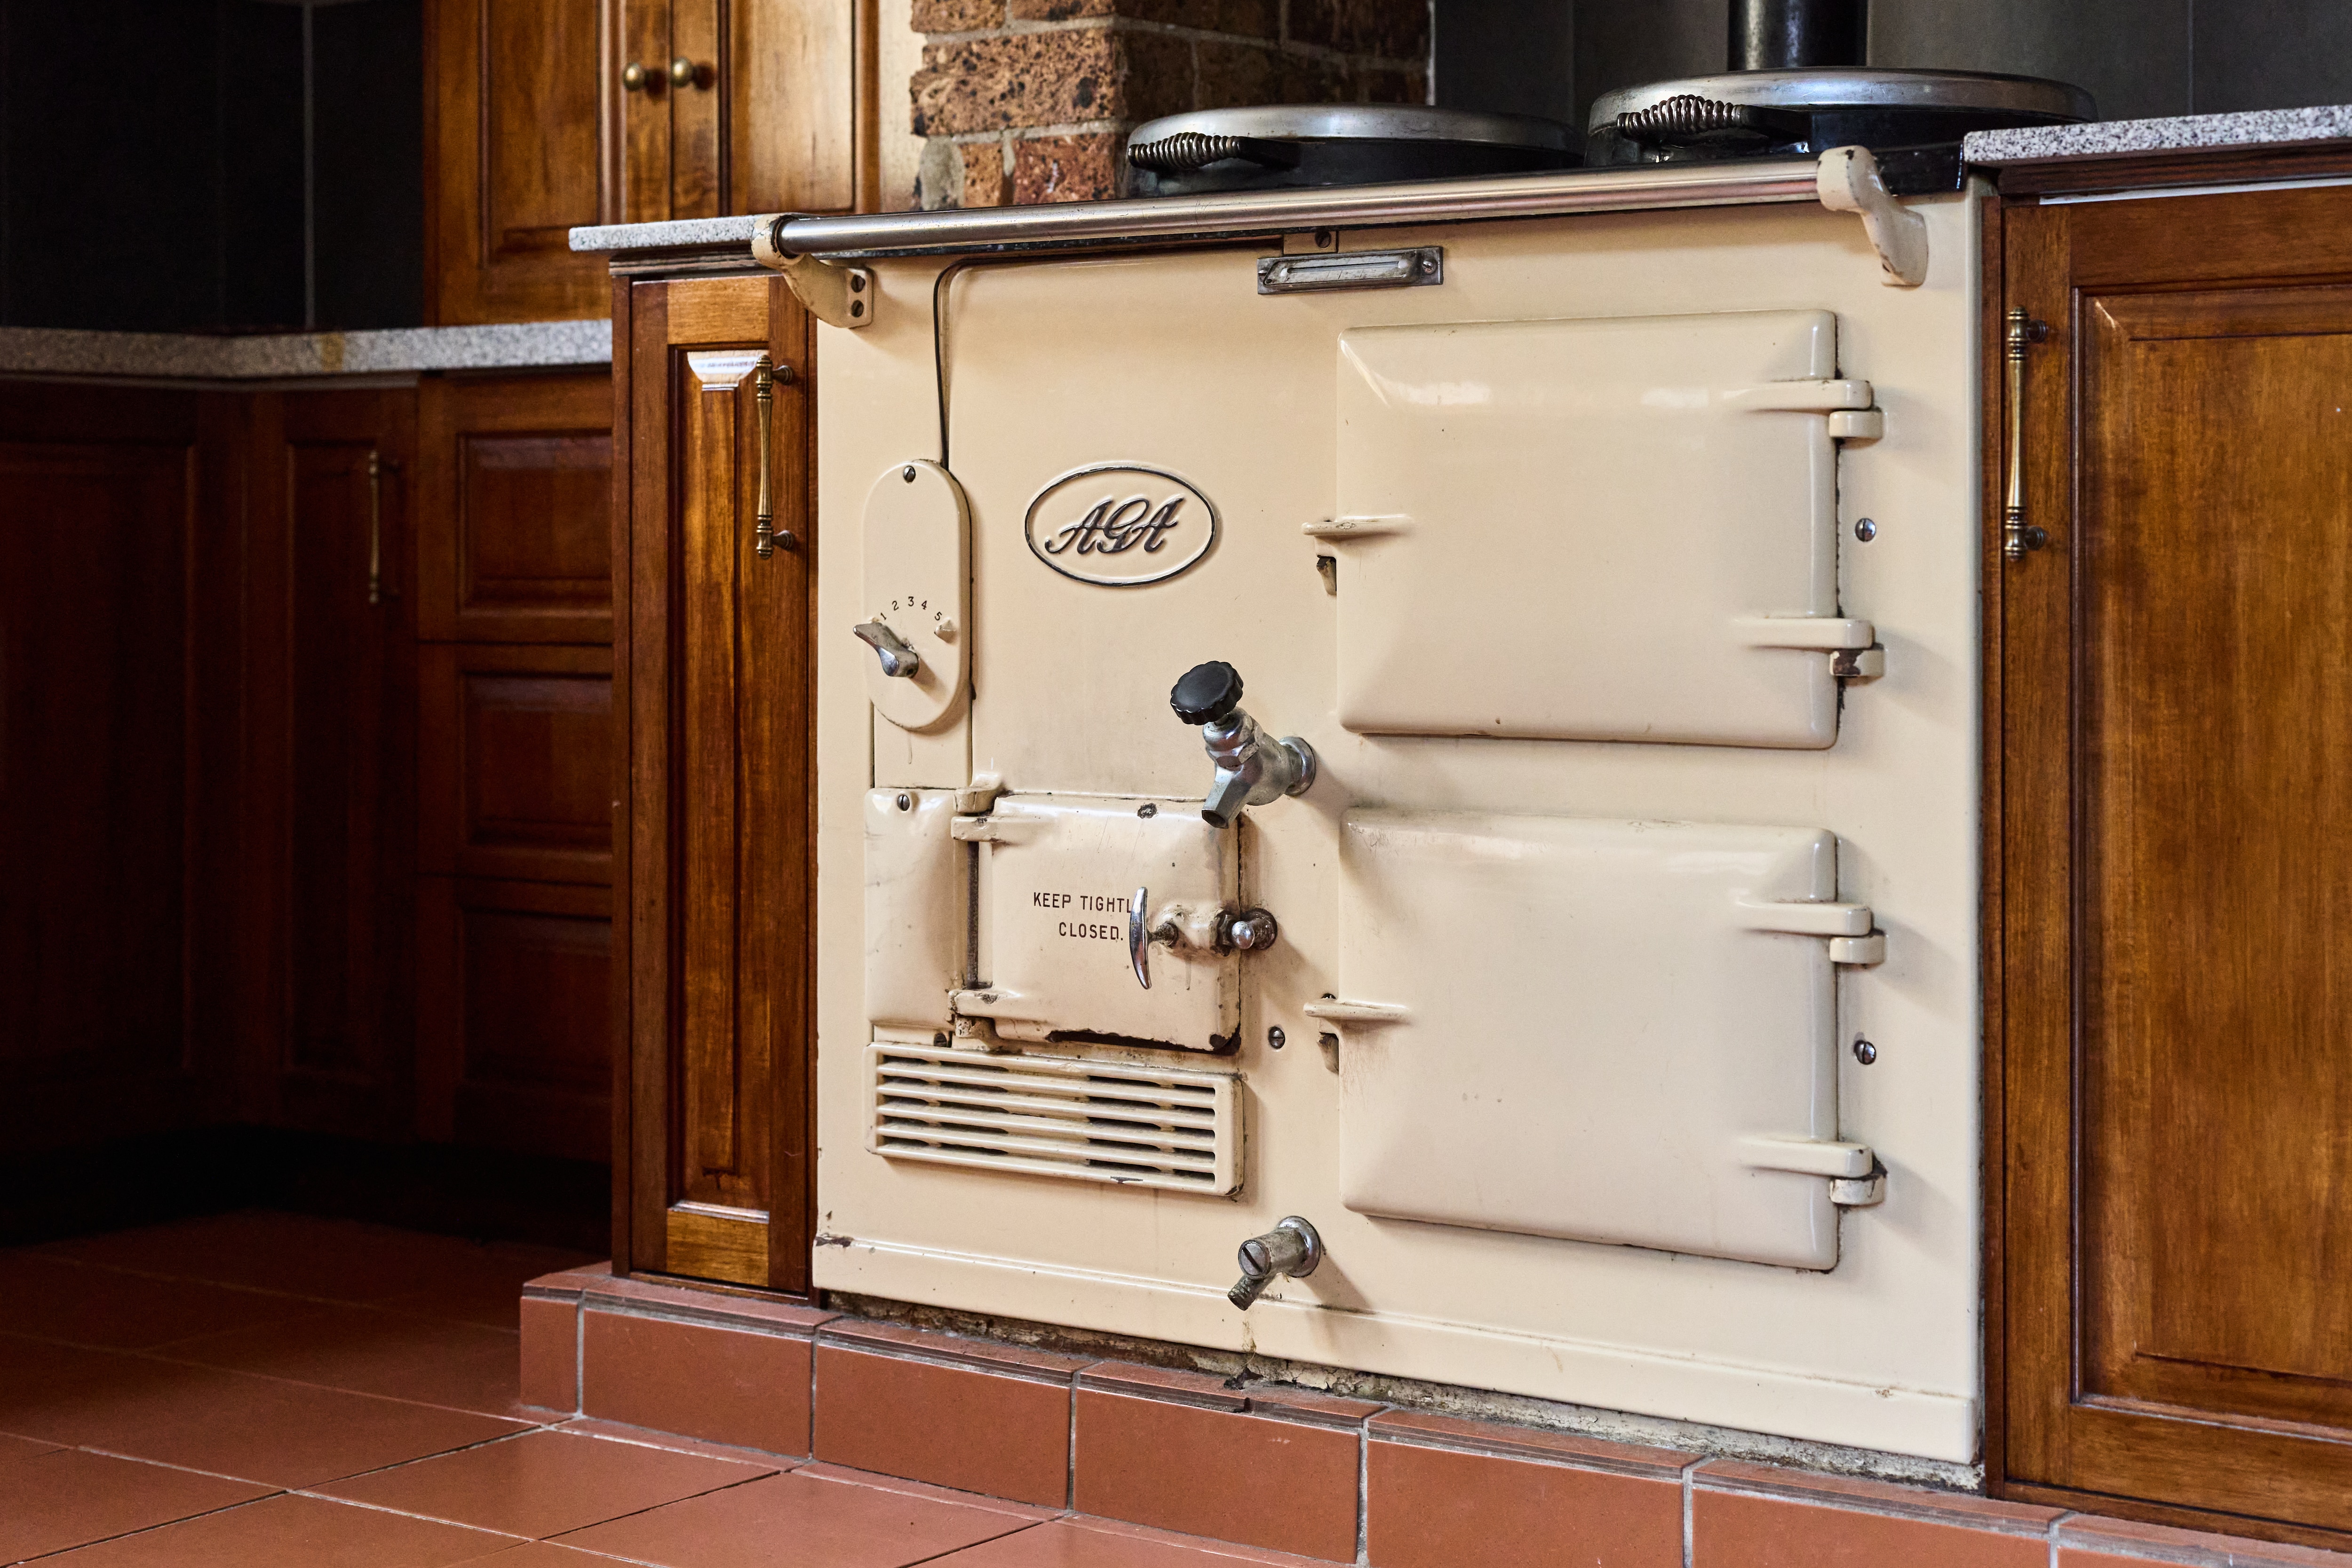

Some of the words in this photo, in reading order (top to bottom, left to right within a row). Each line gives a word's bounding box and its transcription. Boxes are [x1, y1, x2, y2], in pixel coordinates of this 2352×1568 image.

[1044, 496, 1185, 554] AGA
[880, 612, 887, 620] 1
[891, 600, 899, 610] 2
[907, 596, 914, 607] 3
[921, 600, 928, 610] 4
[934, 611, 942, 621] 5
[1033, 892, 1072, 909] KEEP
[1080, 895, 1132, 913] TIGHTL
[1058, 921, 1124, 941] CLOSED.
